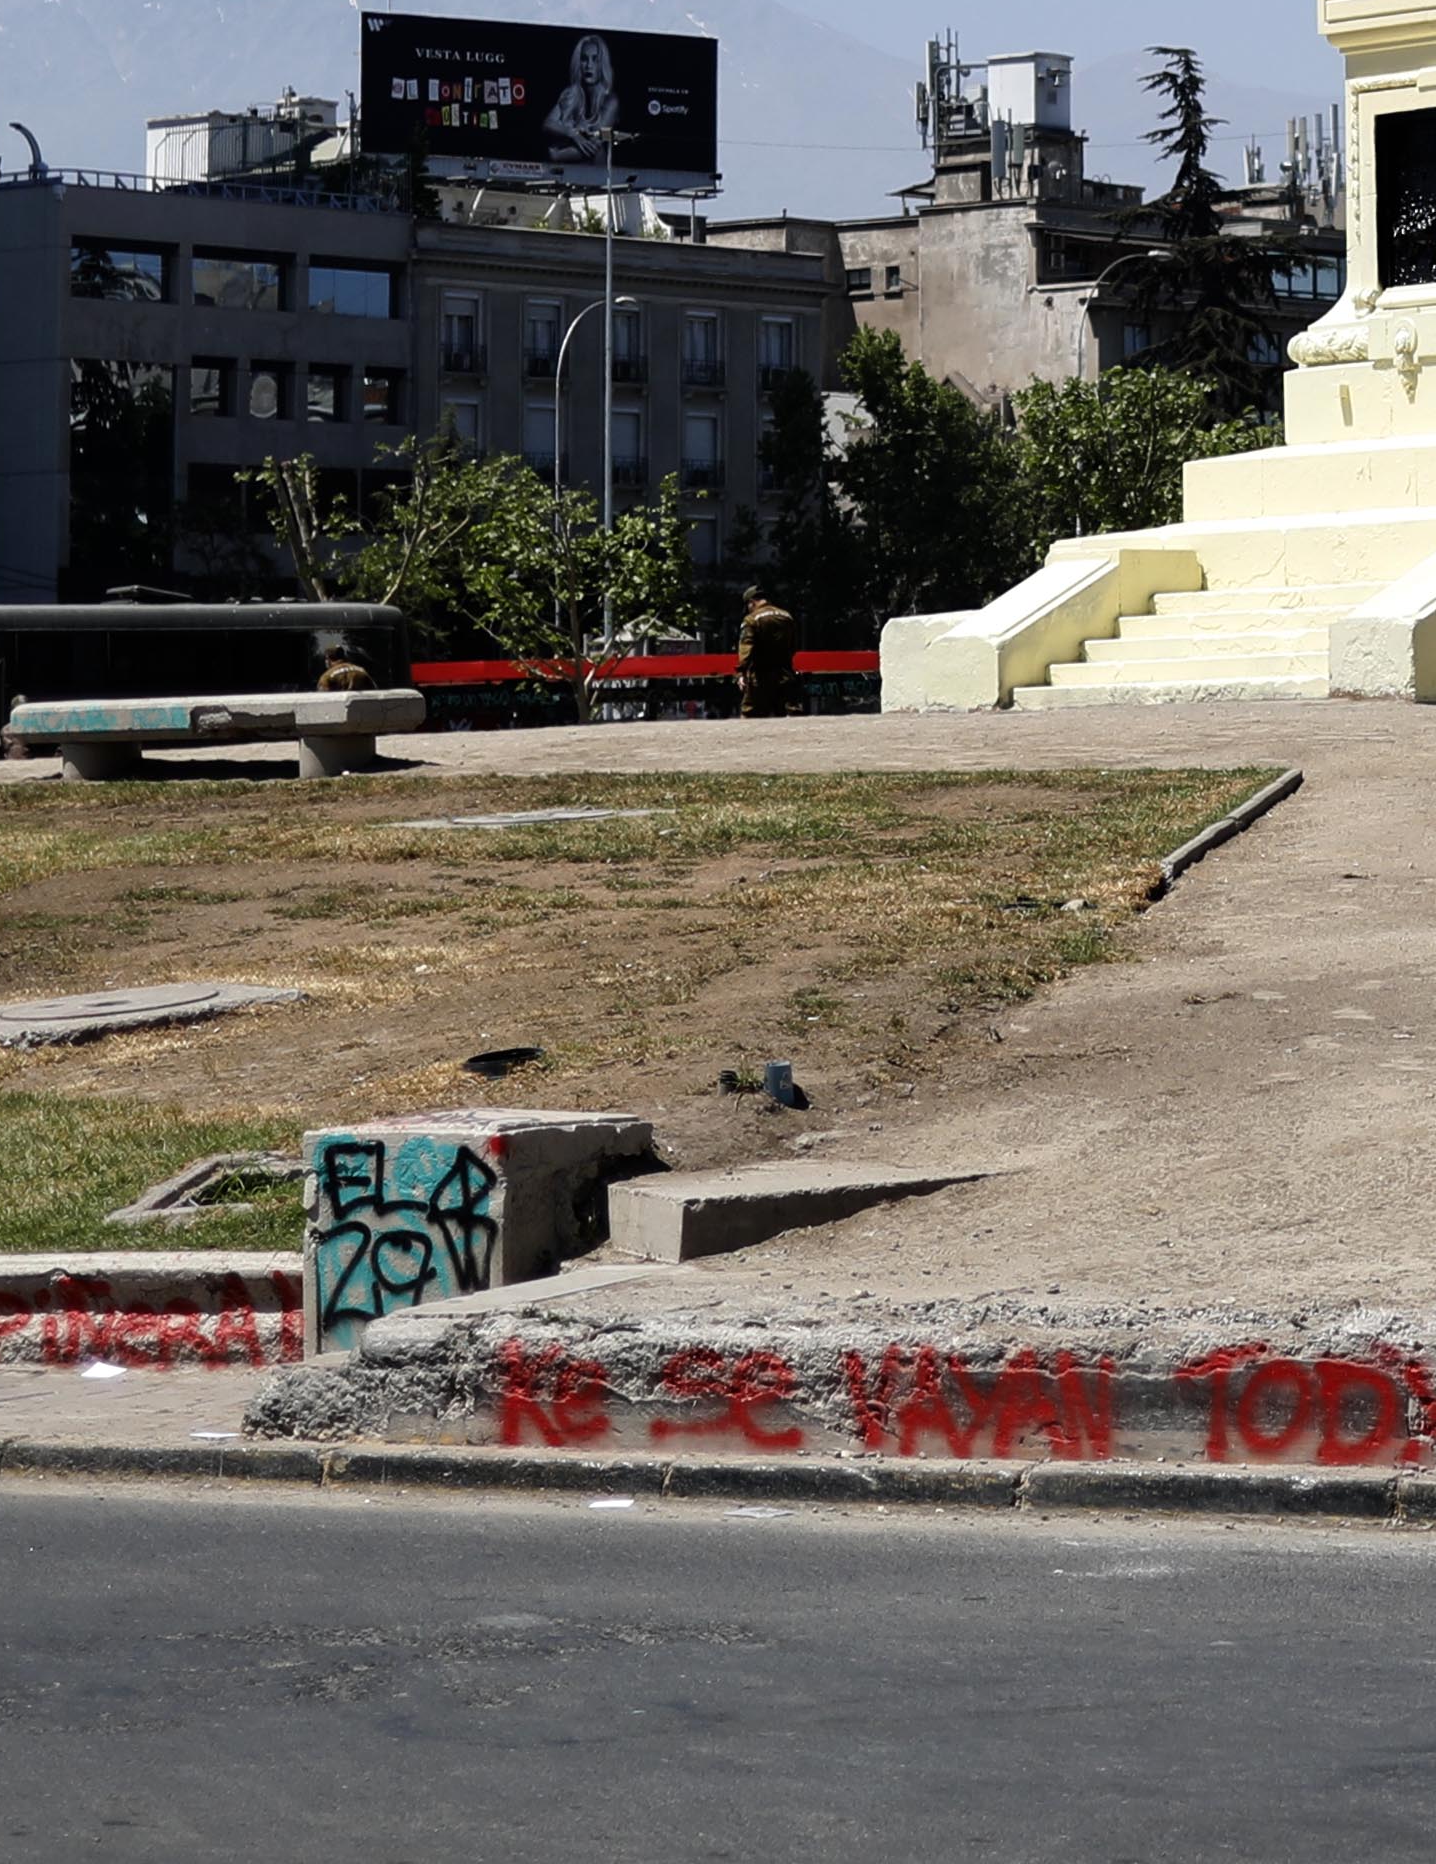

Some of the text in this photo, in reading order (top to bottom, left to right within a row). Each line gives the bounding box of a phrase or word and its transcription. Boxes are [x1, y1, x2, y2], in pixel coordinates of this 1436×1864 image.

[415, 47, 505, 64] VESTA LUGG
[661, 104, 689, 115] Spotify
[840, 1342, 1116, 1460] VAYAN
